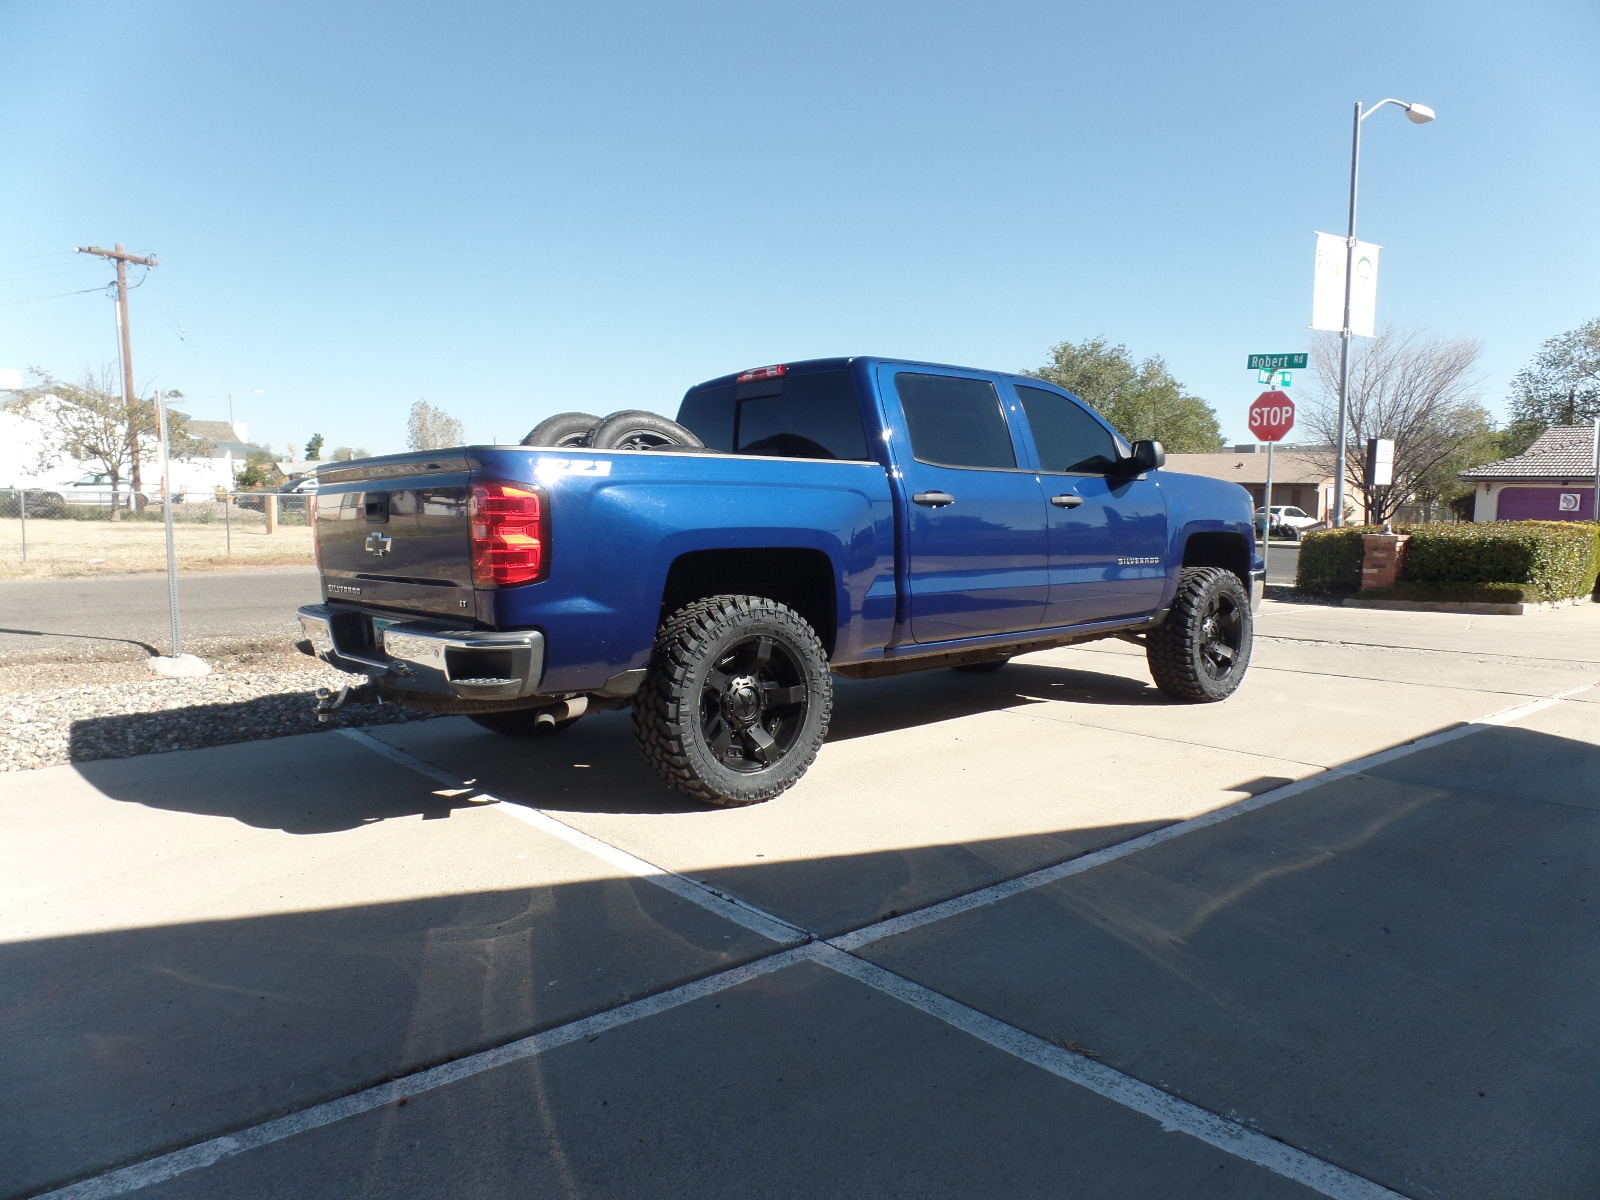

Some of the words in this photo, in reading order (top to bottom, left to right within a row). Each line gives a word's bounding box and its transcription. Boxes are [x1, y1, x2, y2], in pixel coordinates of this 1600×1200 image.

[1252, 355, 1288, 367] Robert
[1293, 354, 1304, 364] Rd
[1251, 406, 1293, 427] STOP
[1118, 557, 1160, 565] SILVERADO
